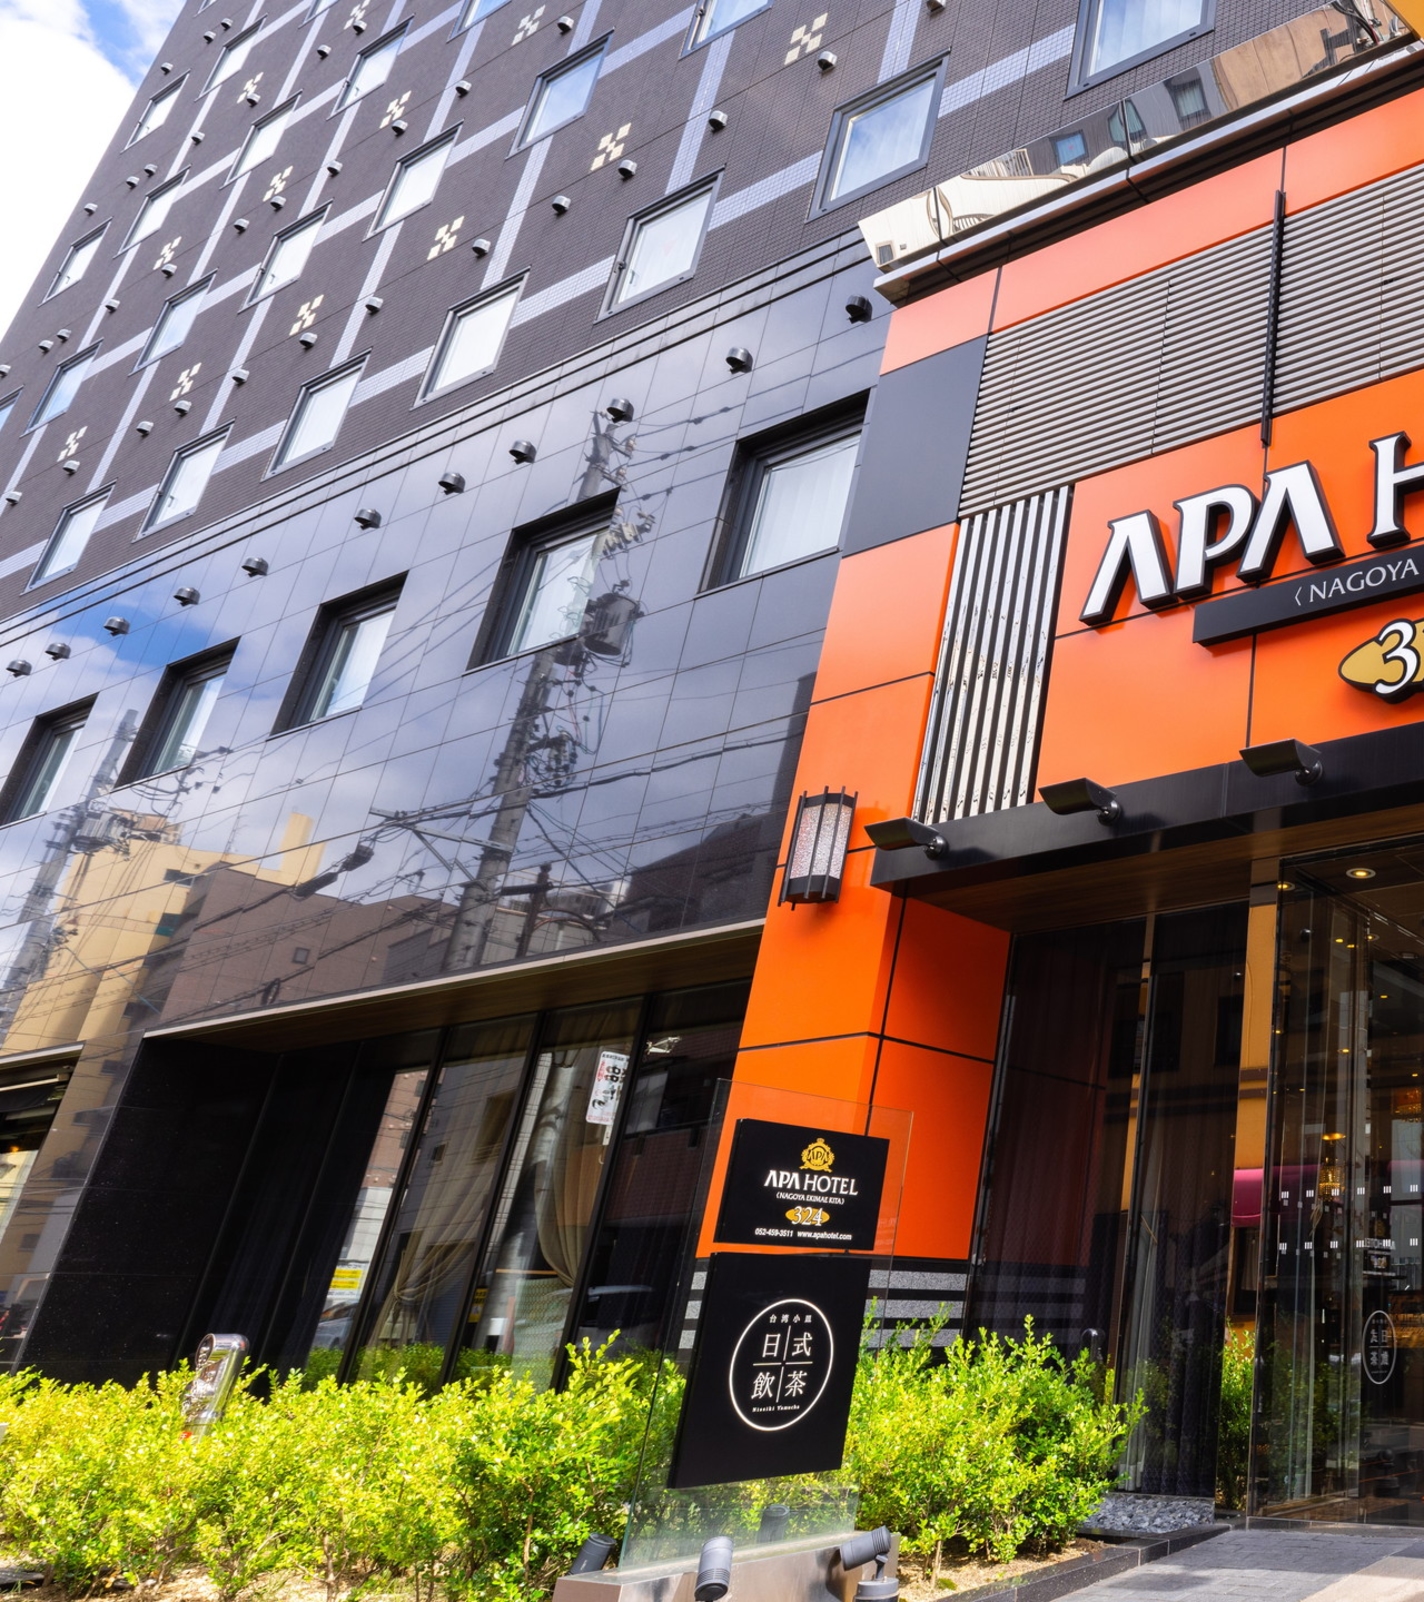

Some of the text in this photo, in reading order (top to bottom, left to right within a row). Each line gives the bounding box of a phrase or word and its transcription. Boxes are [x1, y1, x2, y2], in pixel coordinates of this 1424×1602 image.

[1078, 460, 1345, 626] APA
[764, 1169, 858, 1196] APA HOTEL
[806, 1194, 828, 1204] EKIMAE
[791, 1206, 824, 1226] 324
[755, 1228, 852, 1241] 052-459-3511 www.apahotel.com
